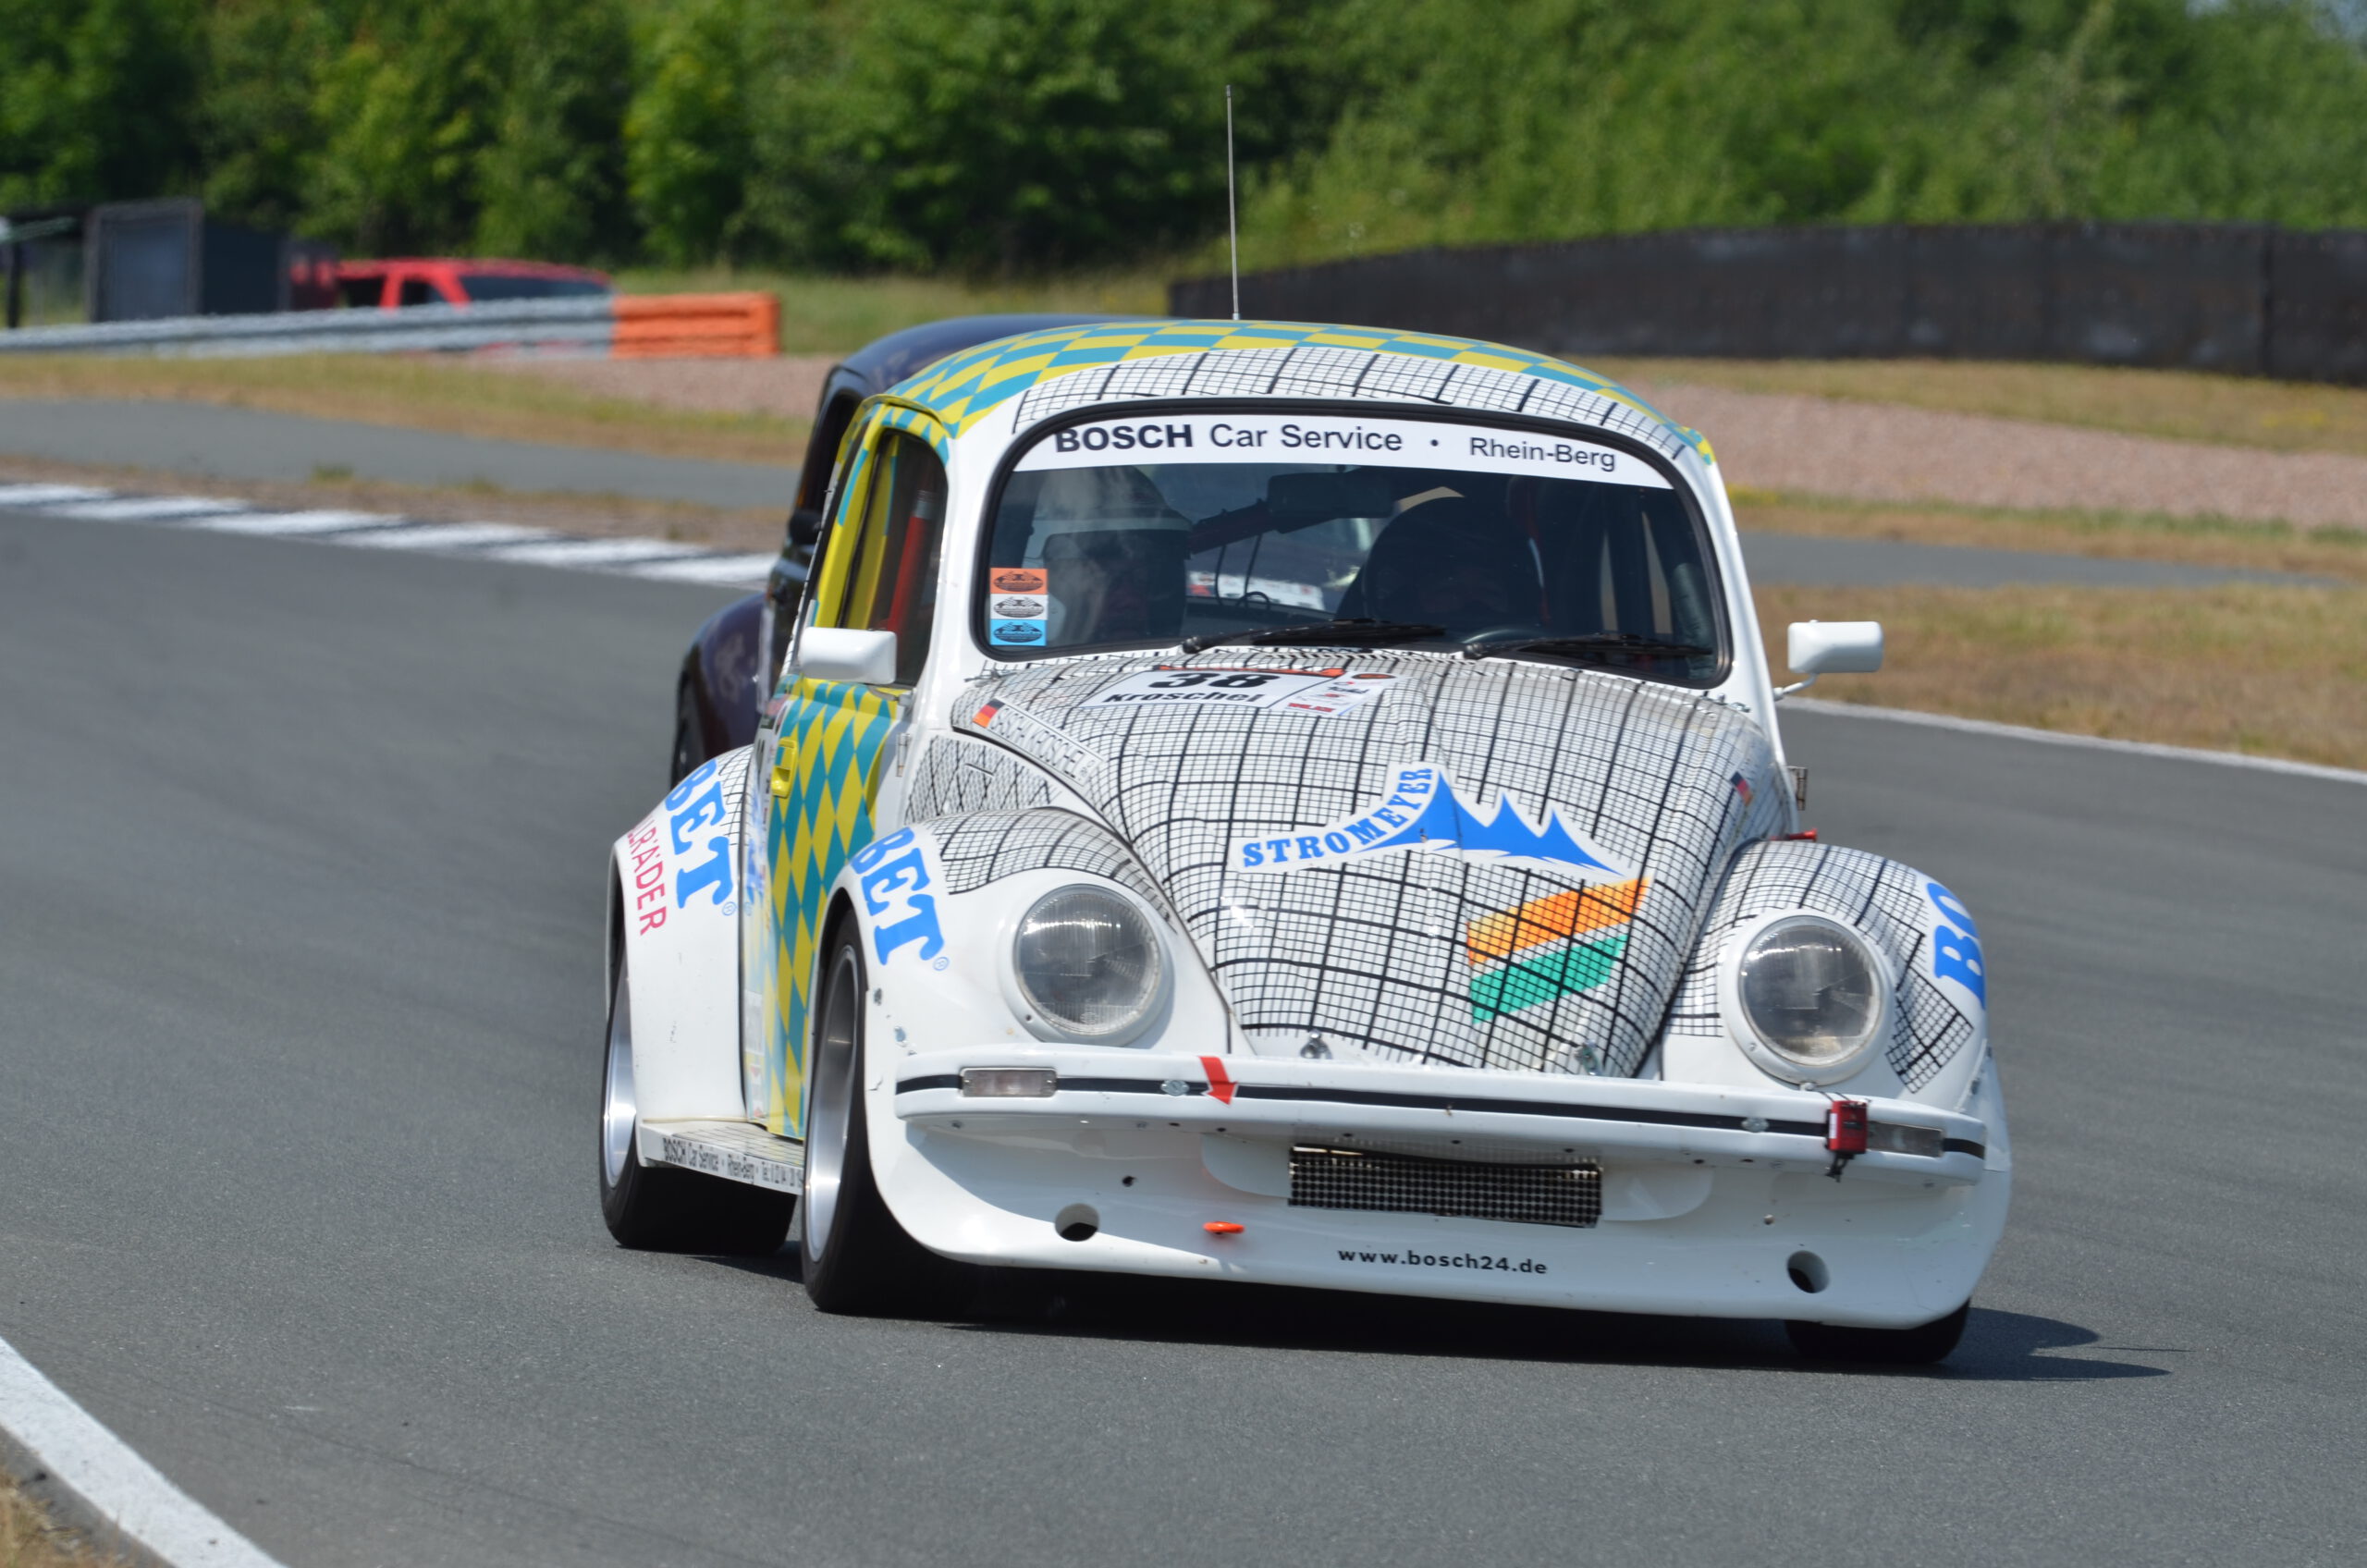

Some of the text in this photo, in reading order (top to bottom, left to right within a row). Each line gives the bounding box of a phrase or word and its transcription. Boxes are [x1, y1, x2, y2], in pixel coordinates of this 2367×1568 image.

[1055, 423, 1616, 472] BOSCH Car Service Rhein-Berg
[1147, 672, 1282, 689] 38
[1102, 691, 1266, 704] Kroschel
[1242, 767, 1434, 868] STROMEYER
[1337, 1249, 1549, 1275] www.bosch24.de
